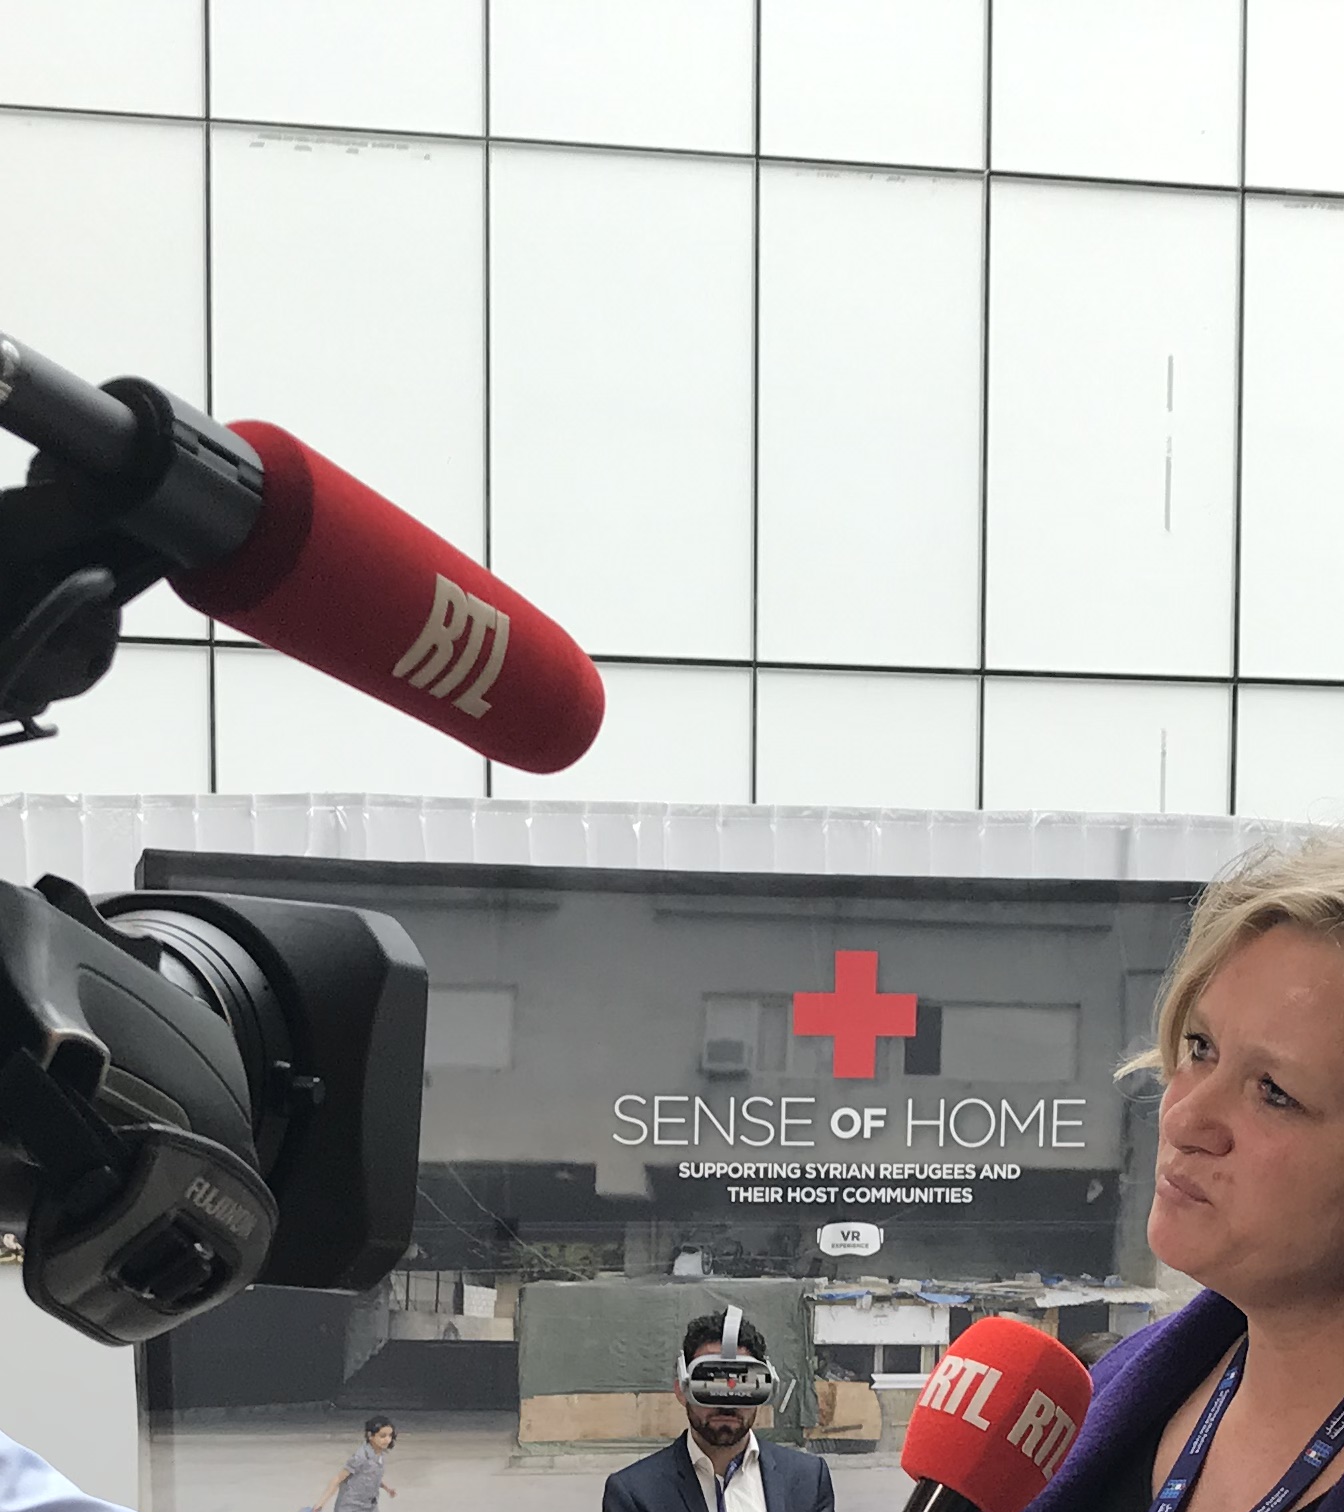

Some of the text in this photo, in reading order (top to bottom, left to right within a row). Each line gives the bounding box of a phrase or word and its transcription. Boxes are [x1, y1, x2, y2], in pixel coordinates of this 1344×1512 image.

[392, 573, 510, 719] RTL
[612, 1095, 1086, 1148] SENSE OF HOME
[678, 1162, 1021, 1181] SUPPORTING SYRIAN REFUGEES AND
[727, 1186, 973, 1204] THEIR HOST COMMUNITIES
[184, 1176, 257, 1240] FUJINON
[840, 1230, 861, 1241] VR
[919, 1355, 1003, 1431] RTL
[1006, 1388, 1076, 1482] RTL
